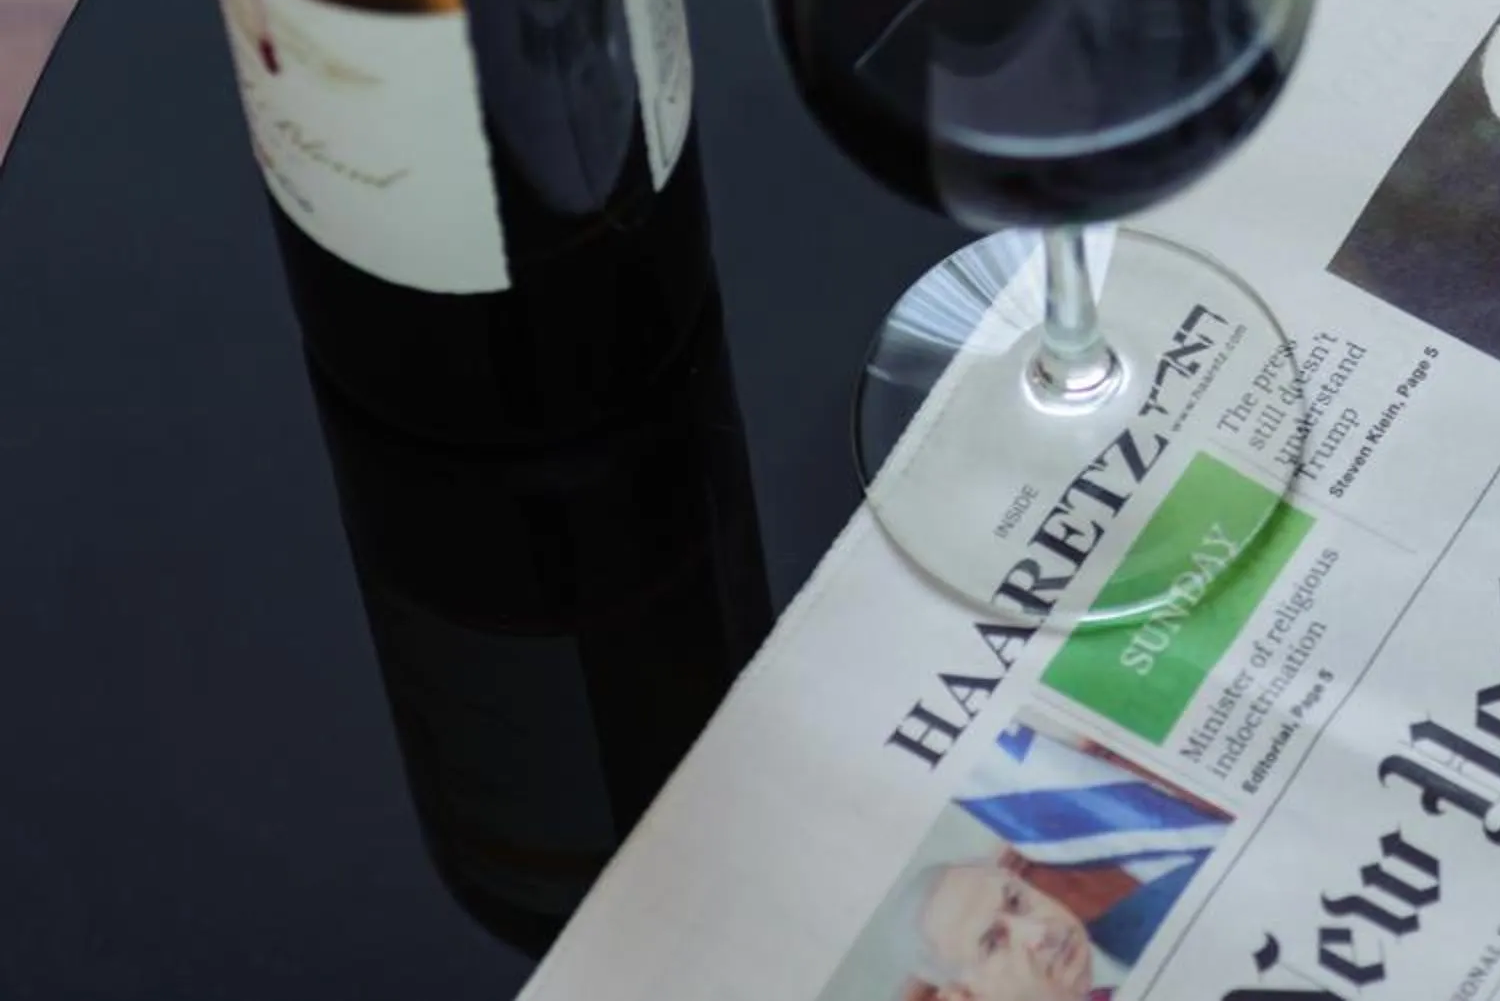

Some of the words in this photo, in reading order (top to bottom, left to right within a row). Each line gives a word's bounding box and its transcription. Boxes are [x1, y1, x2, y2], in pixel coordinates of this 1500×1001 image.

[1125, 299, 1233, 428] הארץ
[1166, 321, 1250, 433] www.haaretz.com
[1215, 385, 1263, 439] The
[1250, 332, 1304, 395] press
[1242, 401, 1288, 453] still
[1272, 326, 1341, 409] doesn't
[1268, 337, 1369, 468] understand
[1327, 440, 1375, 500] Steven
[1364, 395, 1408, 447] Klein,
[1394, 354, 1436, 402] Page
[1423, 343, 1440, 359] 5
[1293, 401, 1366, 488] Trump
[992, 482, 1040, 541] INSIDE
[883, 405, 1171, 779] HAARETZ
[1117, 520, 1243, 680] SUNDAY
[1178, 663, 1260, 766] Minister
[1242, 636, 1278, 672] of
[1260, 542, 1346, 648] religious
[1204, 614, 1331, 782] indoctrination
[1238, 715, 1304, 797] Editorial,
[1291, 677, 1331, 723] Page
[1317, 666, 1335, 682] 5
